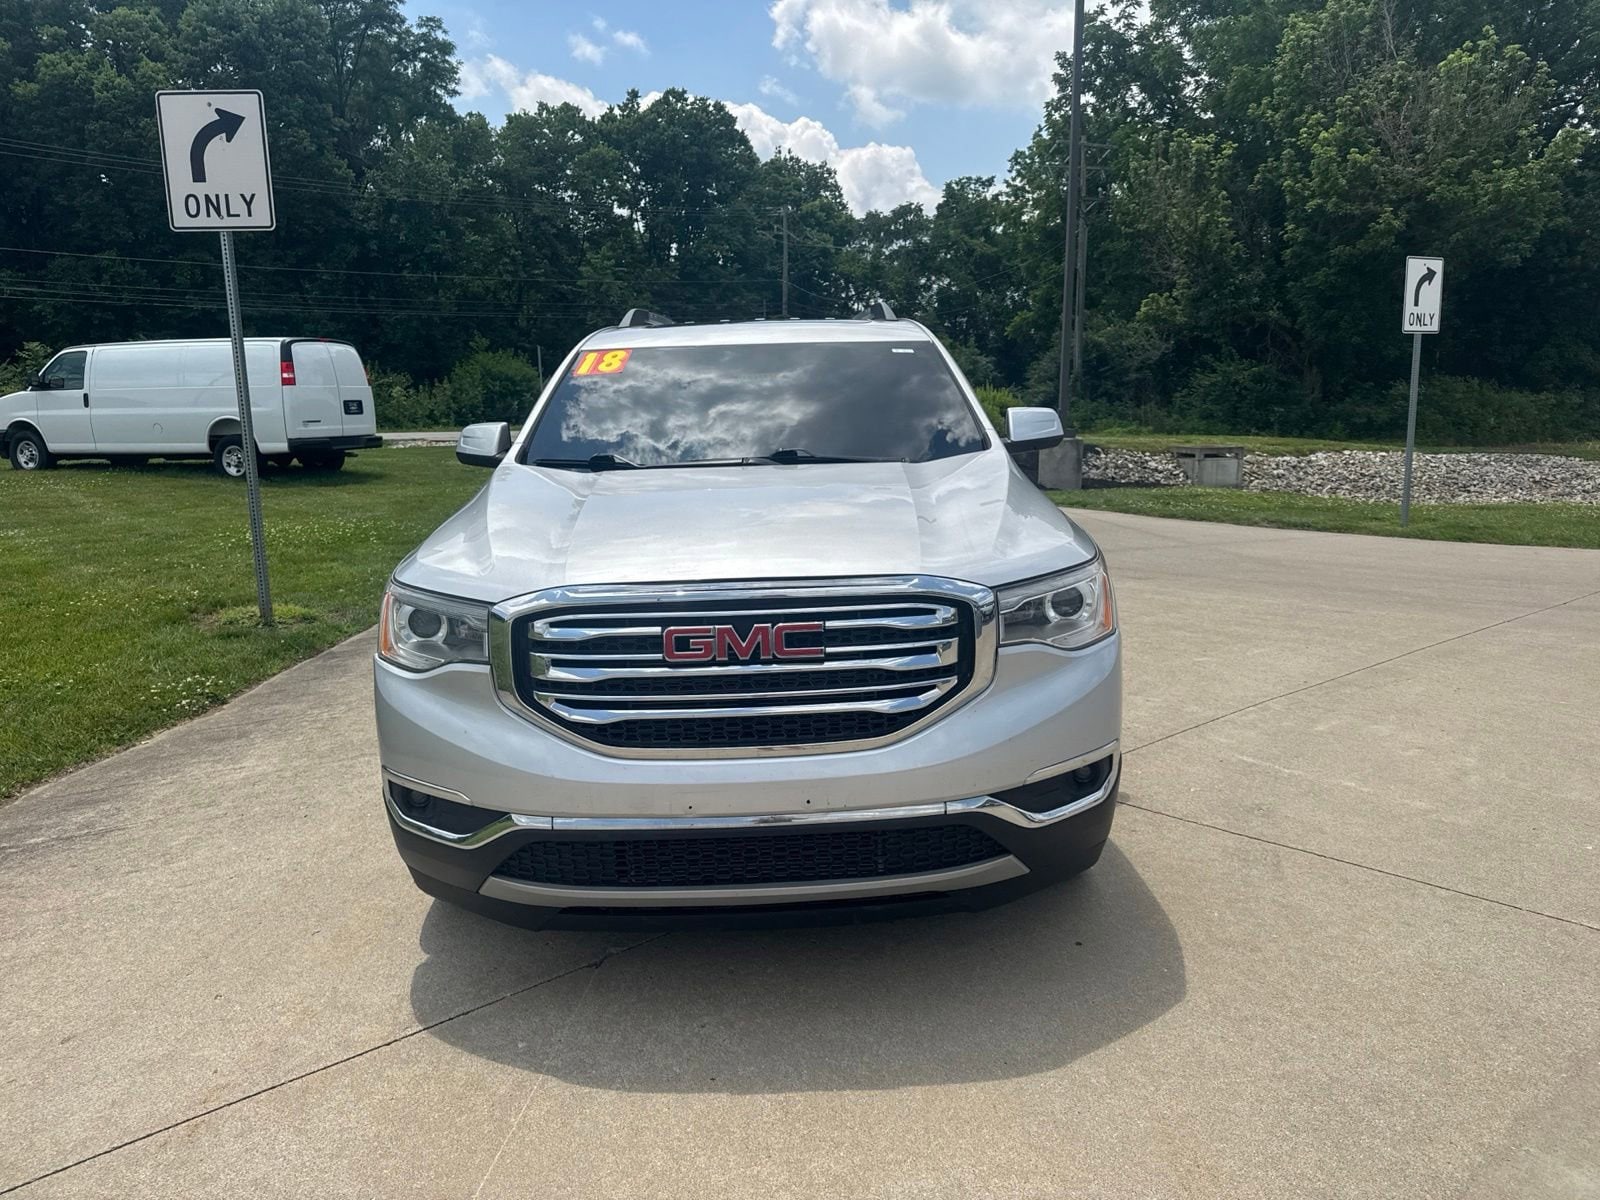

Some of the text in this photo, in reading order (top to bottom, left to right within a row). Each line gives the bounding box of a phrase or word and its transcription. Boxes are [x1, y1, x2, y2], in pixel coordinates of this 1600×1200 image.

[184, 193, 256, 219] ONLY
[1408, 312, 1435, 327] ONLY
[576, 350, 627, 375] 18
[663, 621, 825, 662] GMC
